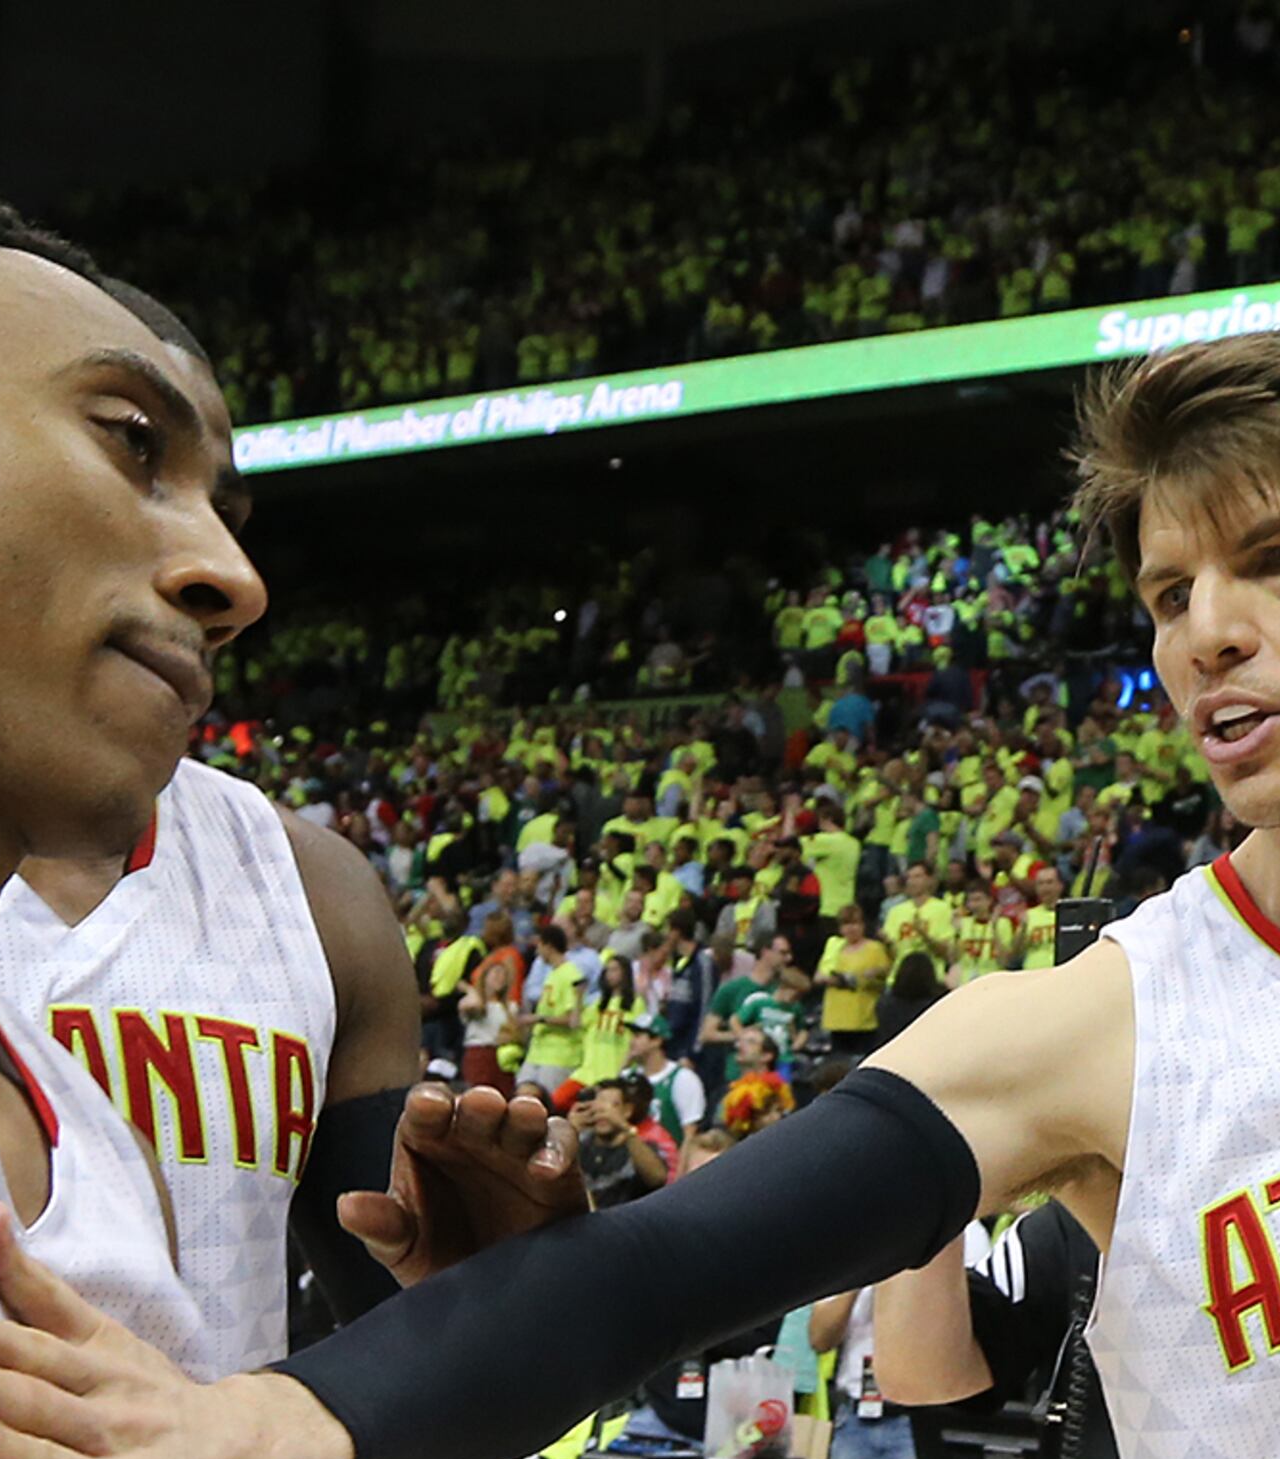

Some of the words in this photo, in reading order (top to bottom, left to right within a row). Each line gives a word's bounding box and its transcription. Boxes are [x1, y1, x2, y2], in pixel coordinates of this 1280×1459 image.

[233, 423, 331, 468] Official
[332, 410, 451, 453] Plumber
[452, 400, 491, 437] of
[585, 381, 683, 419] Arena
